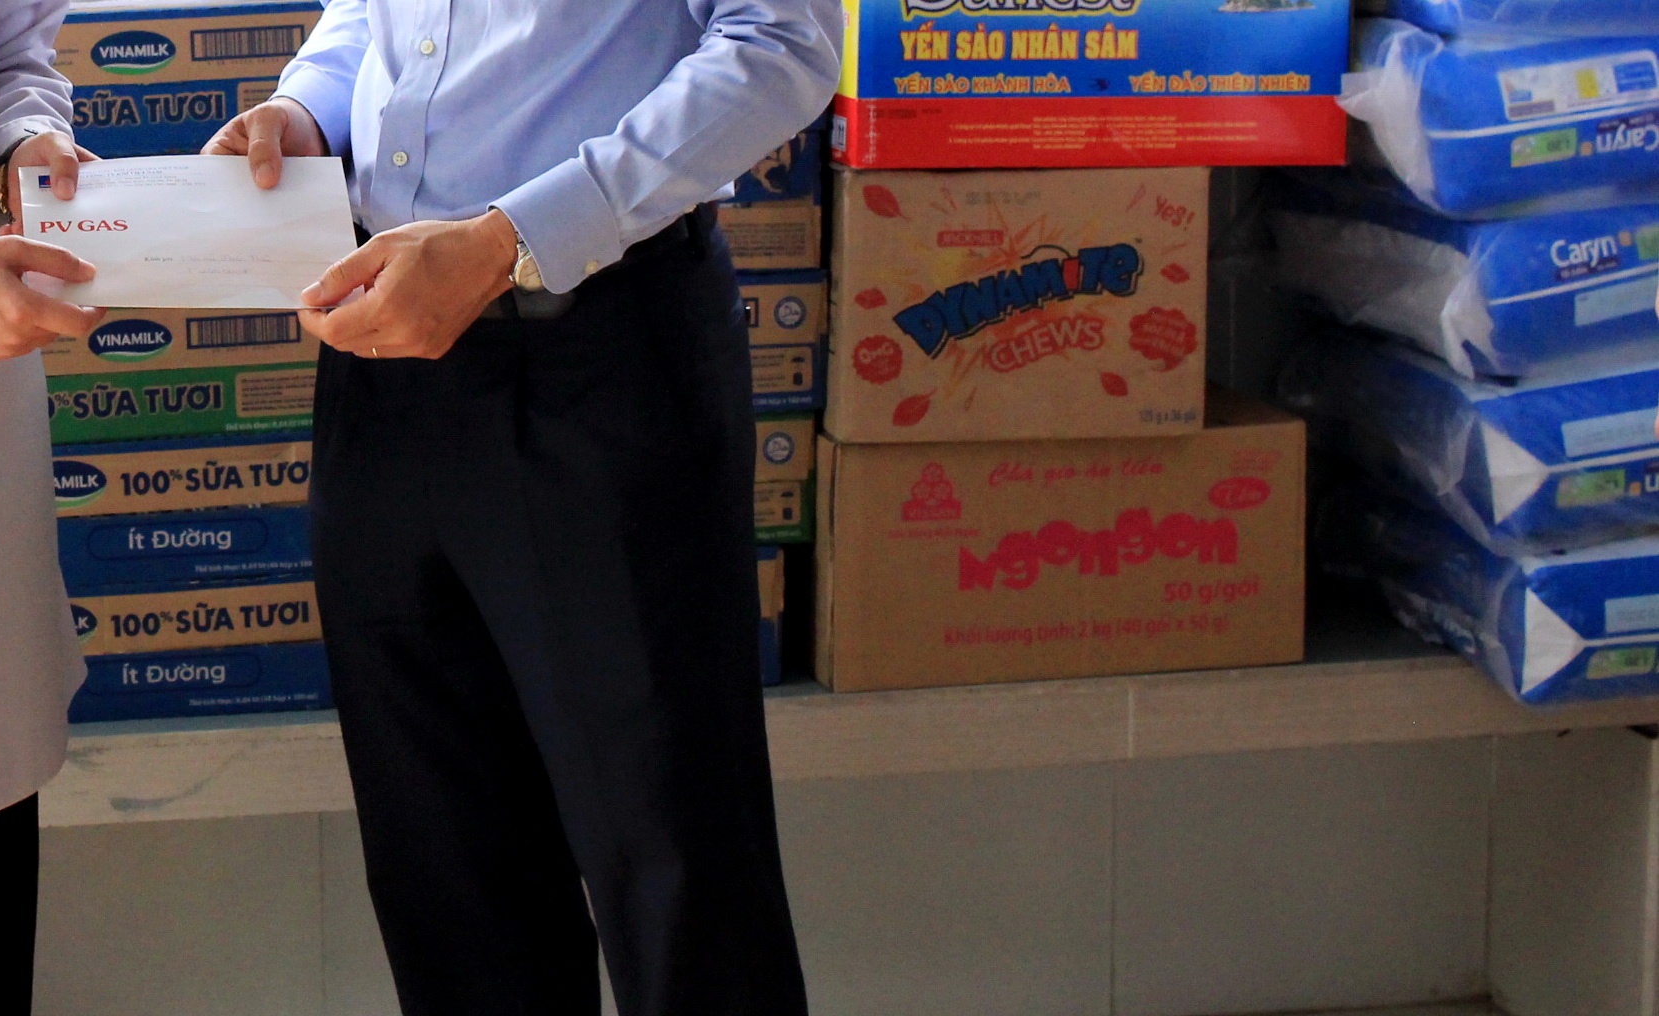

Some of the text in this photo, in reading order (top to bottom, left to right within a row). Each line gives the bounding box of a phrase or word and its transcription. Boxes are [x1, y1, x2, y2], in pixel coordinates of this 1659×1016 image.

[99, 42, 170, 59] VINAMILK
[900, 21, 948, 61] YẾN
[1011, 25, 1079, 60] NHÂN
[1085, 23, 1139, 60] SÂM
[895, 73, 933, 94] YẾN
[972, 74, 1031, 93] KHÁNH
[1033, 72, 1071, 93] HÒA
[1129, 70, 1165, 92] YẾN
[1209, 71, 1256, 91] THIÊN
[1258, 72, 1311, 91] NHIÊN
[72, 90, 227, 128] SỮA TƯƠI
[39, 219, 128, 233] PV GAS
[1551, 235, 1617, 268] Caryn
[96, 330, 165, 347] VINAMILK
[990, 315, 1104, 372] CHEWS
[72, 383, 138, 420] SỮA
[144, 382, 224, 414] TƯƠI
[120, 460, 309, 496] 100% SỮA TƯƠ
[129, 528, 232, 551] Ít Đường
[111, 601, 309, 637] 100% SỮA TƯƠI
[122, 663, 226, 686] Ít Đường
